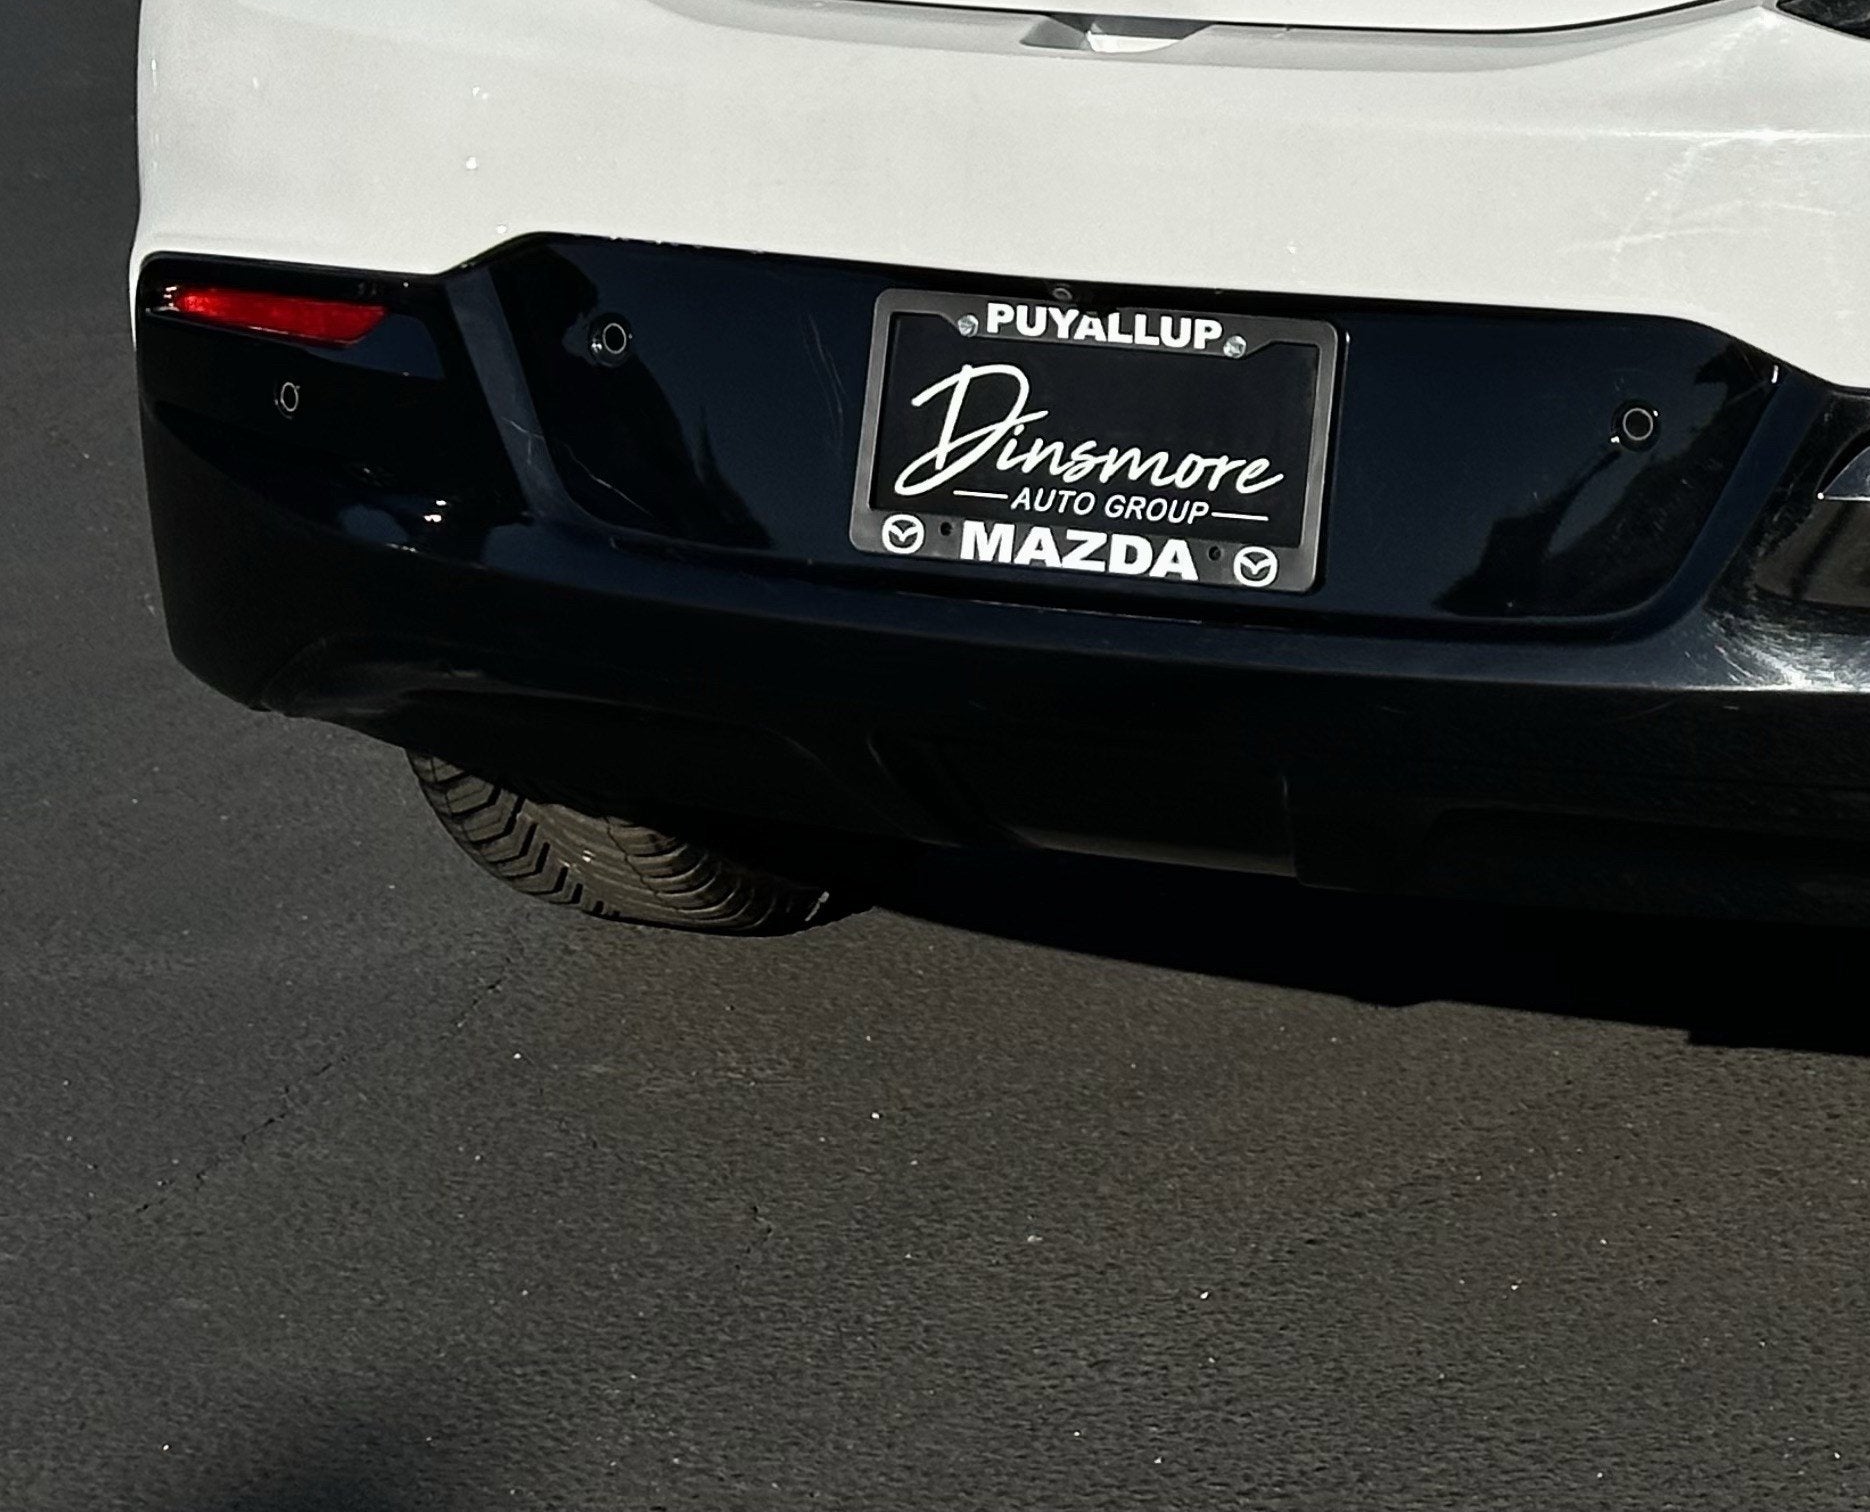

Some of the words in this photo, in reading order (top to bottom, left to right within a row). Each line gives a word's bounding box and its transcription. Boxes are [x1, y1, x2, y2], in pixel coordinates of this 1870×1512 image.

[986, 302, 1224, 350] PUYALLUP
[894, 364, 1284, 495] Dinsmore
[1010, 492, 1096, 517] AUTO
[1104, 496, 1210, 525] GROUP
[960, 520, 1199, 582] MAZDA
